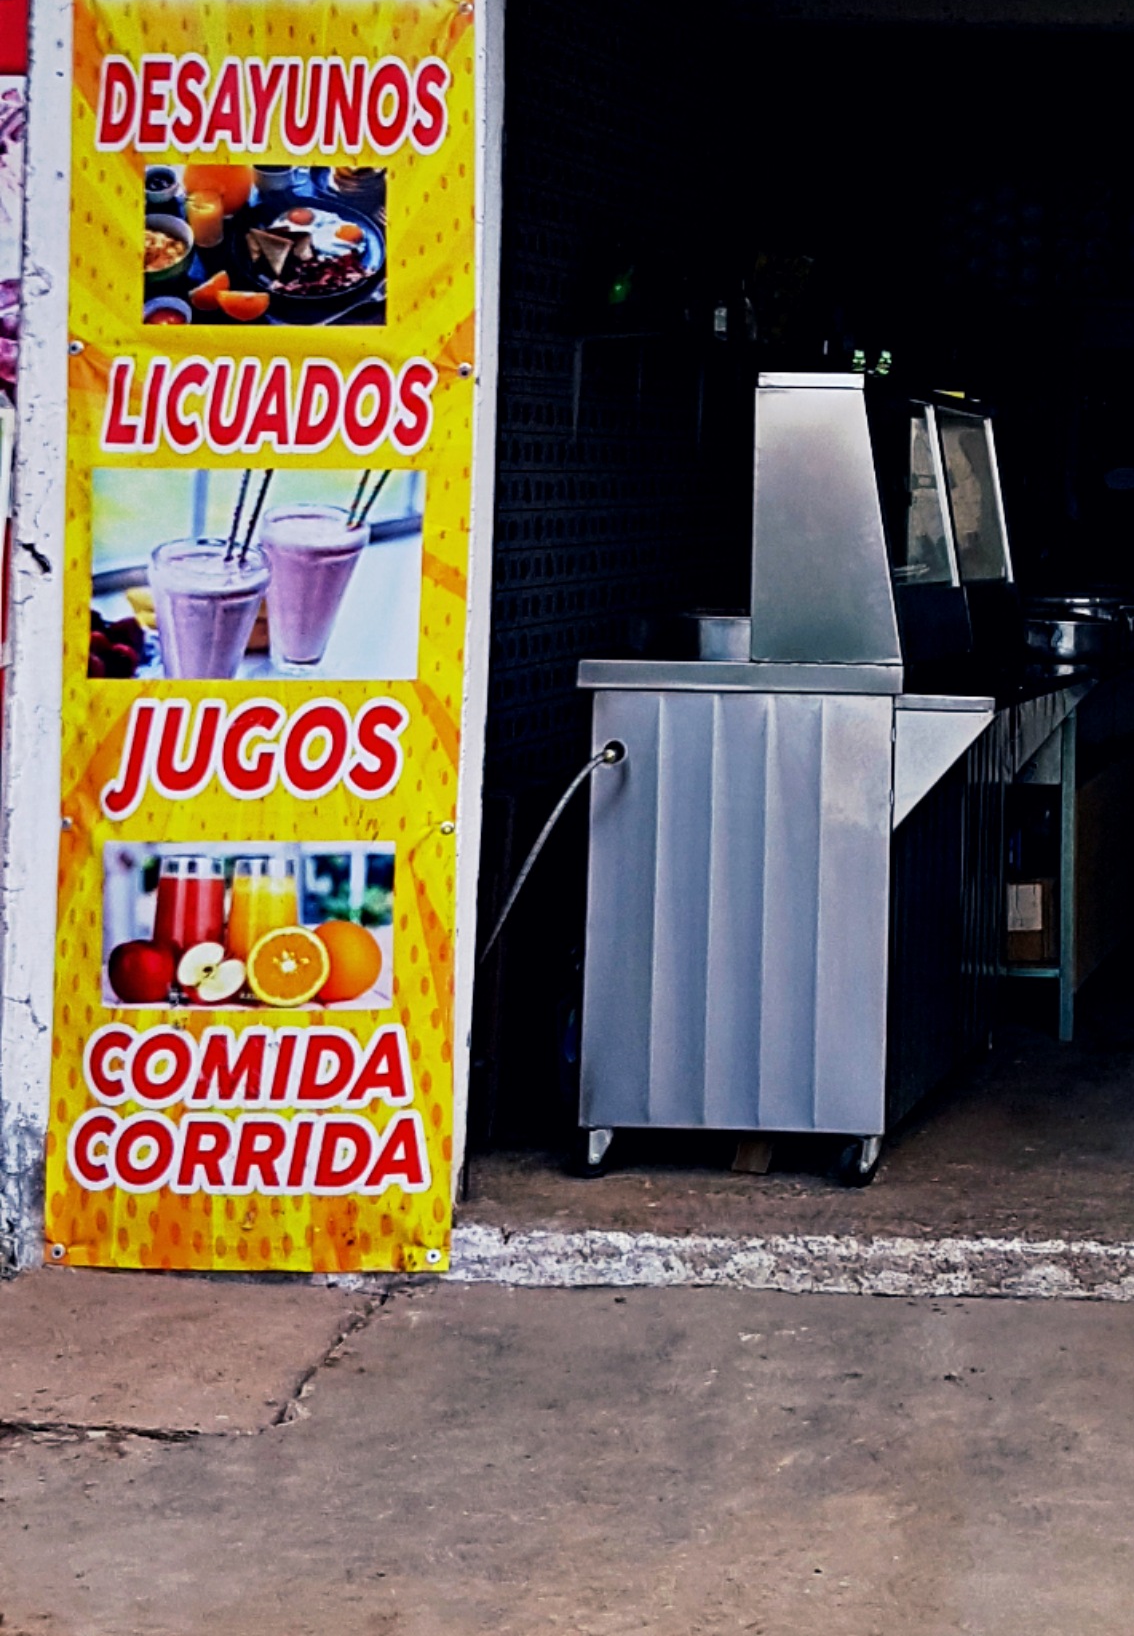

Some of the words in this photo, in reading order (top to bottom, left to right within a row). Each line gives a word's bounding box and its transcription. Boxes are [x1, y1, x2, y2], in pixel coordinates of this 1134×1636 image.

[97, 57, 448, 151] DESAYUNOS
[103, 360, 438, 451] LICUADOS
[103, 702, 406, 815] JUGOS
[86, 1027, 409, 1104] COMIDA
[71, 1112, 427, 1190] CORRIDA
